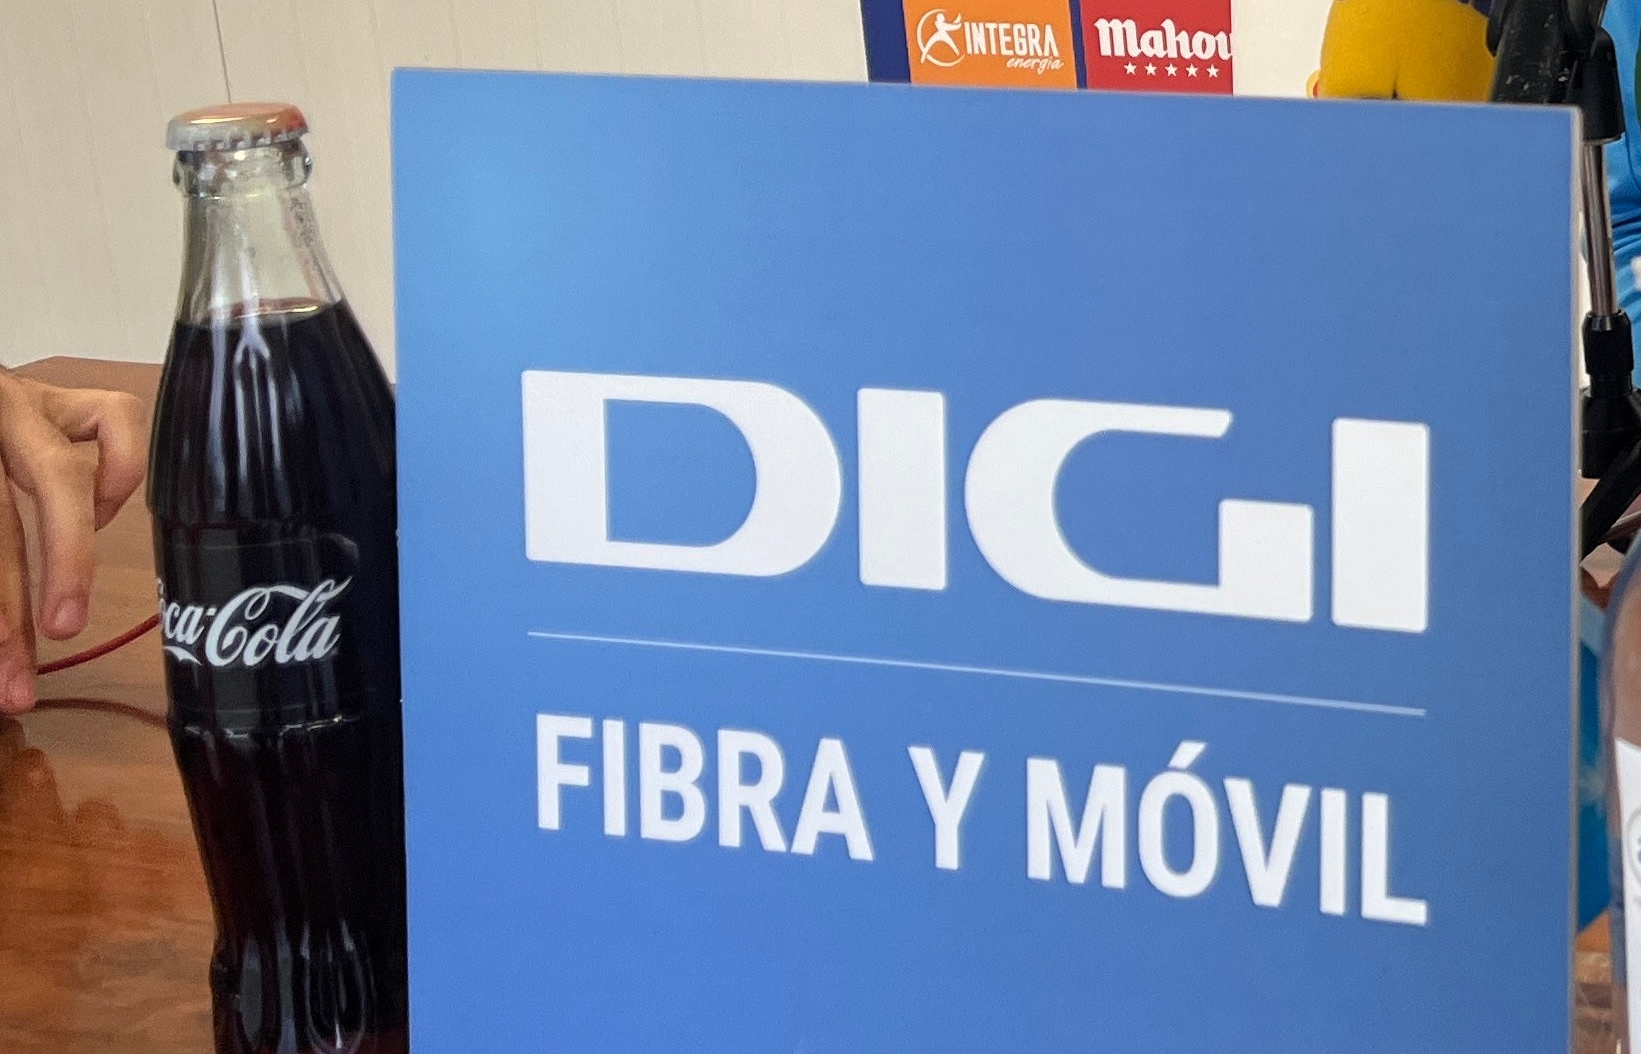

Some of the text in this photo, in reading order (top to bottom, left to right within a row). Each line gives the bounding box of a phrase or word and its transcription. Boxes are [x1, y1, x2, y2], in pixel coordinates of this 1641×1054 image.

[964, 21, 1060, 58] INTEGRA
[521, 369, 1430, 633] DIGI
[536, 712, 1428, 926] FIBRA Y MÓVIL
